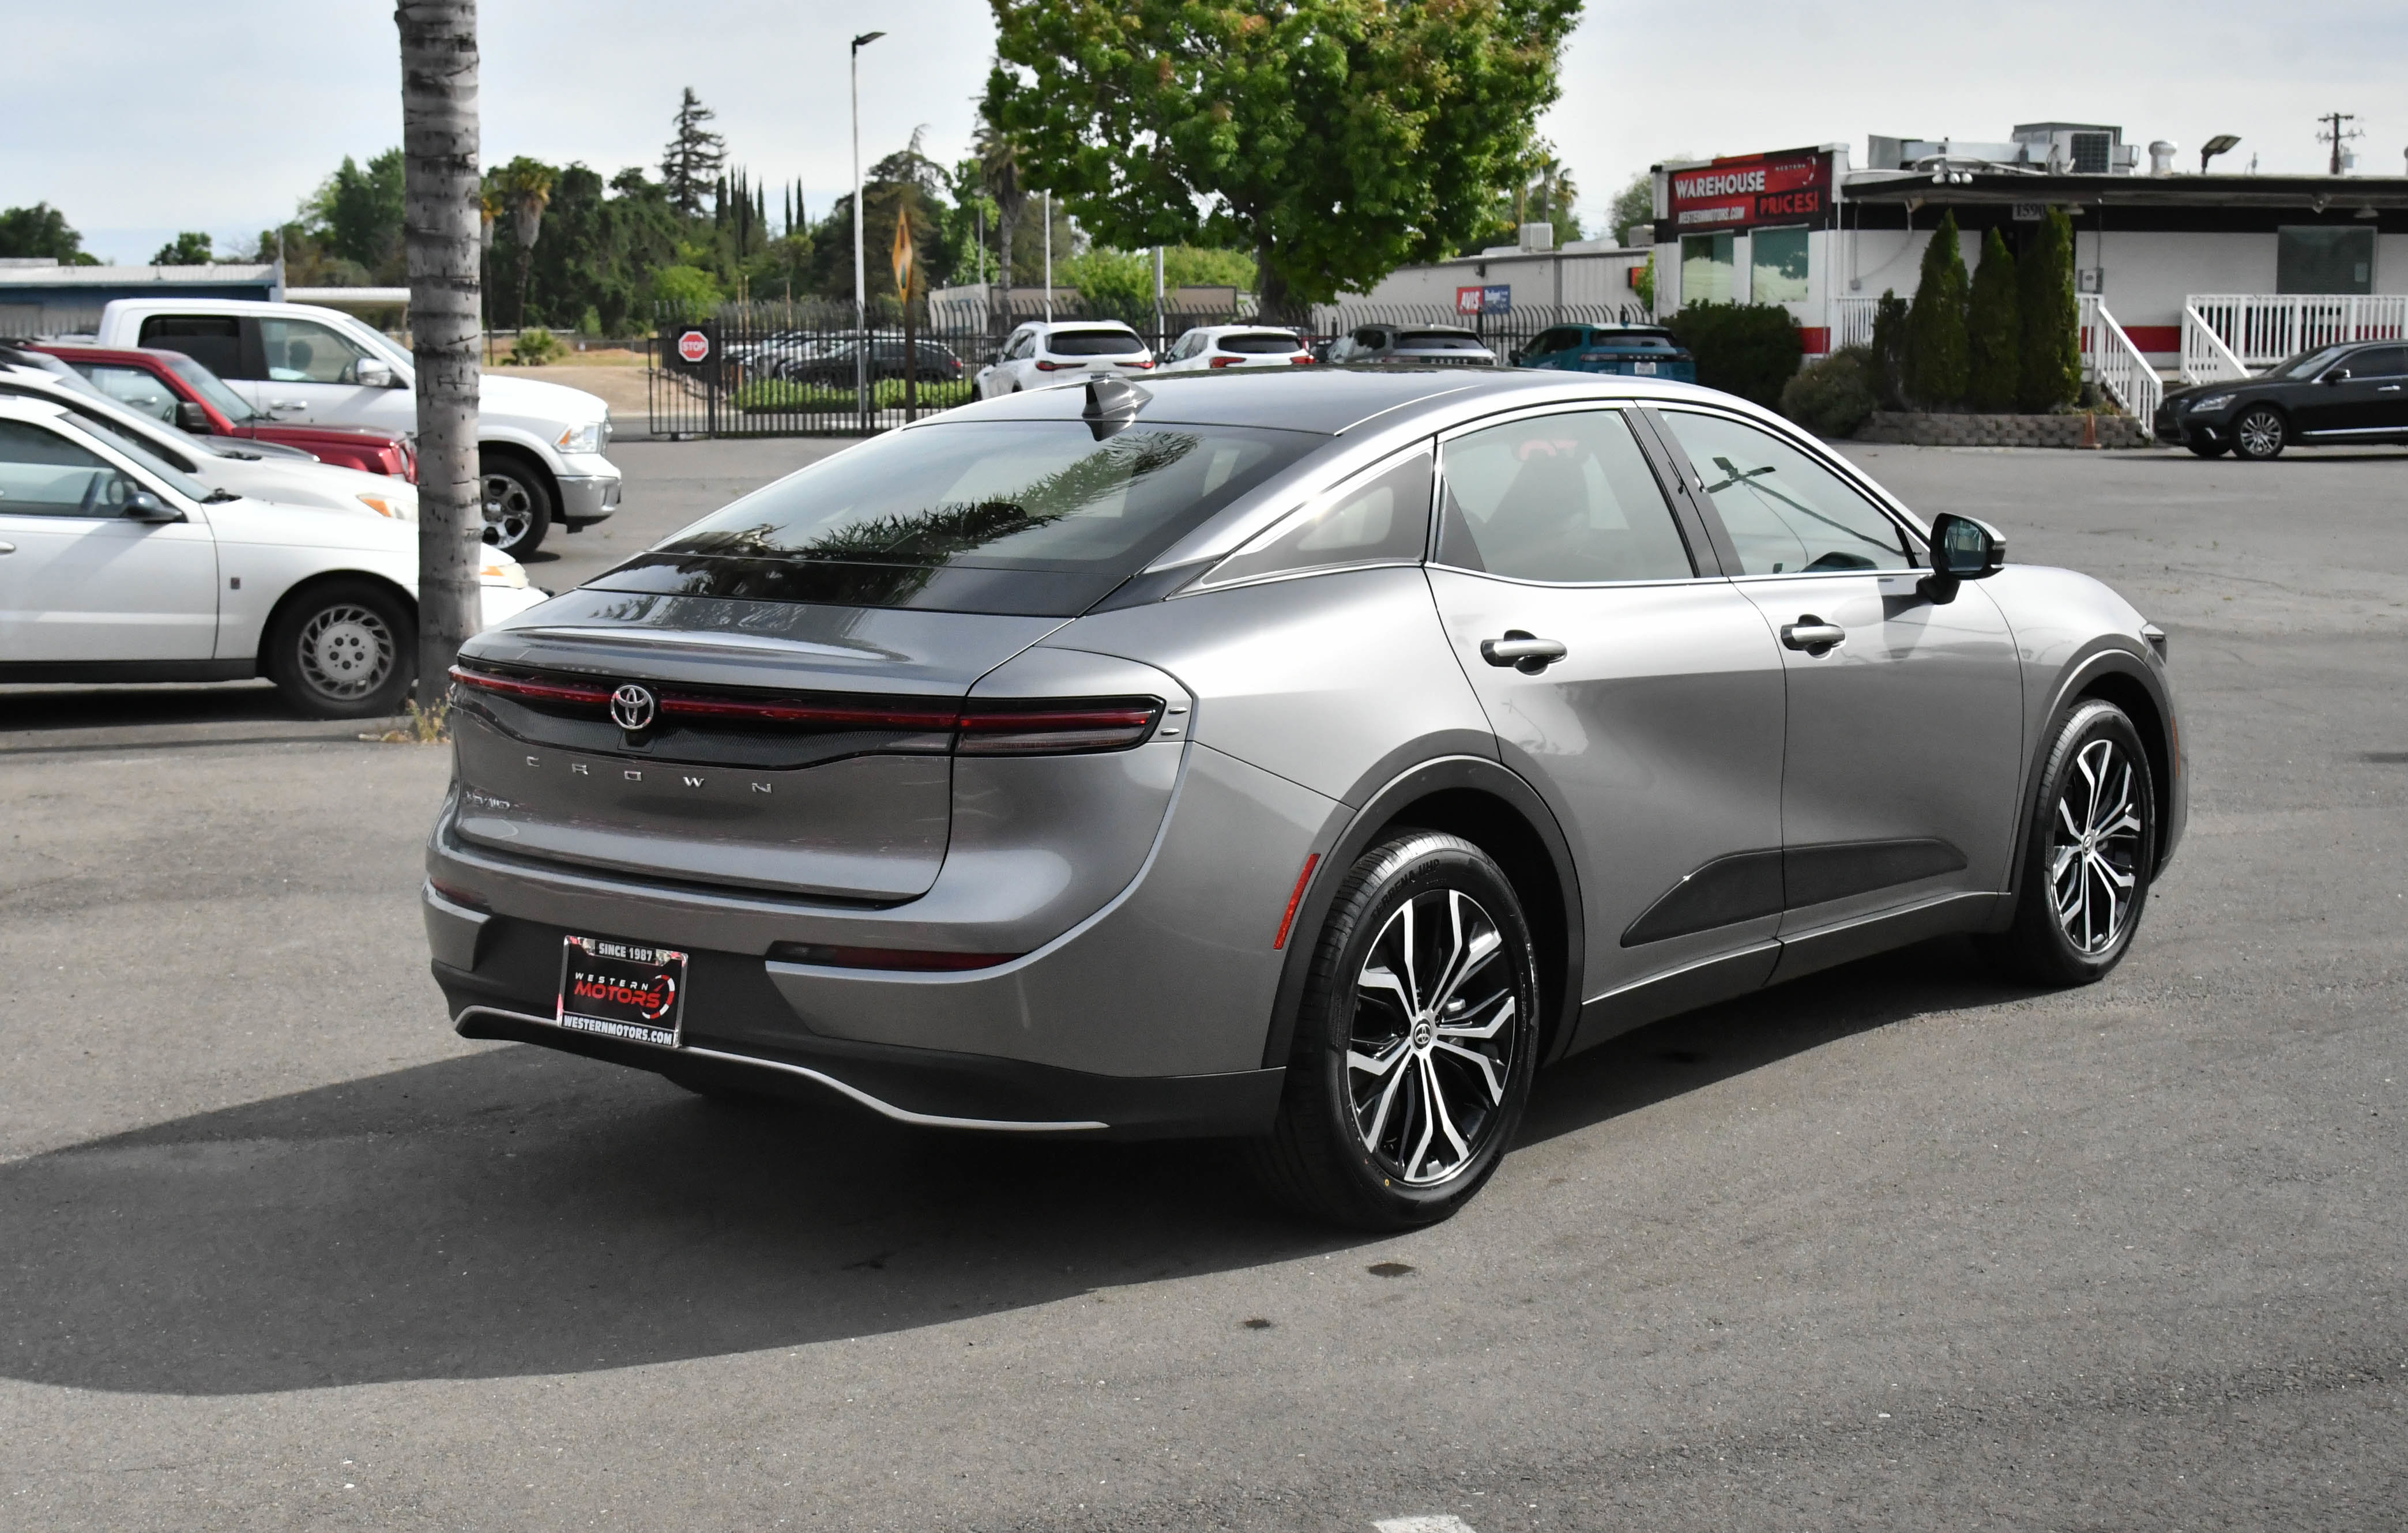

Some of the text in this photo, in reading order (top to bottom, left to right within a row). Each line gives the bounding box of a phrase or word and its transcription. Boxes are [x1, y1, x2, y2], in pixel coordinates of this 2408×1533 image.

[1675, 170, 1766, 199] WAREHOUSE
[1760, 190, 1819, 215] PRICES!
[1460, 291, 1480, 310] AVIS
[682, 341, 706, 351] STOP
[526, 756, 773, 794] CROWN
[599, 943, 652, 961] SINCE 1987
[574, 971, 649, 990] WESTERN
[574, 981, 661, 1008] MOTORS
[563, 1015, 672, 1045] WESTERNMOTORS.COM
